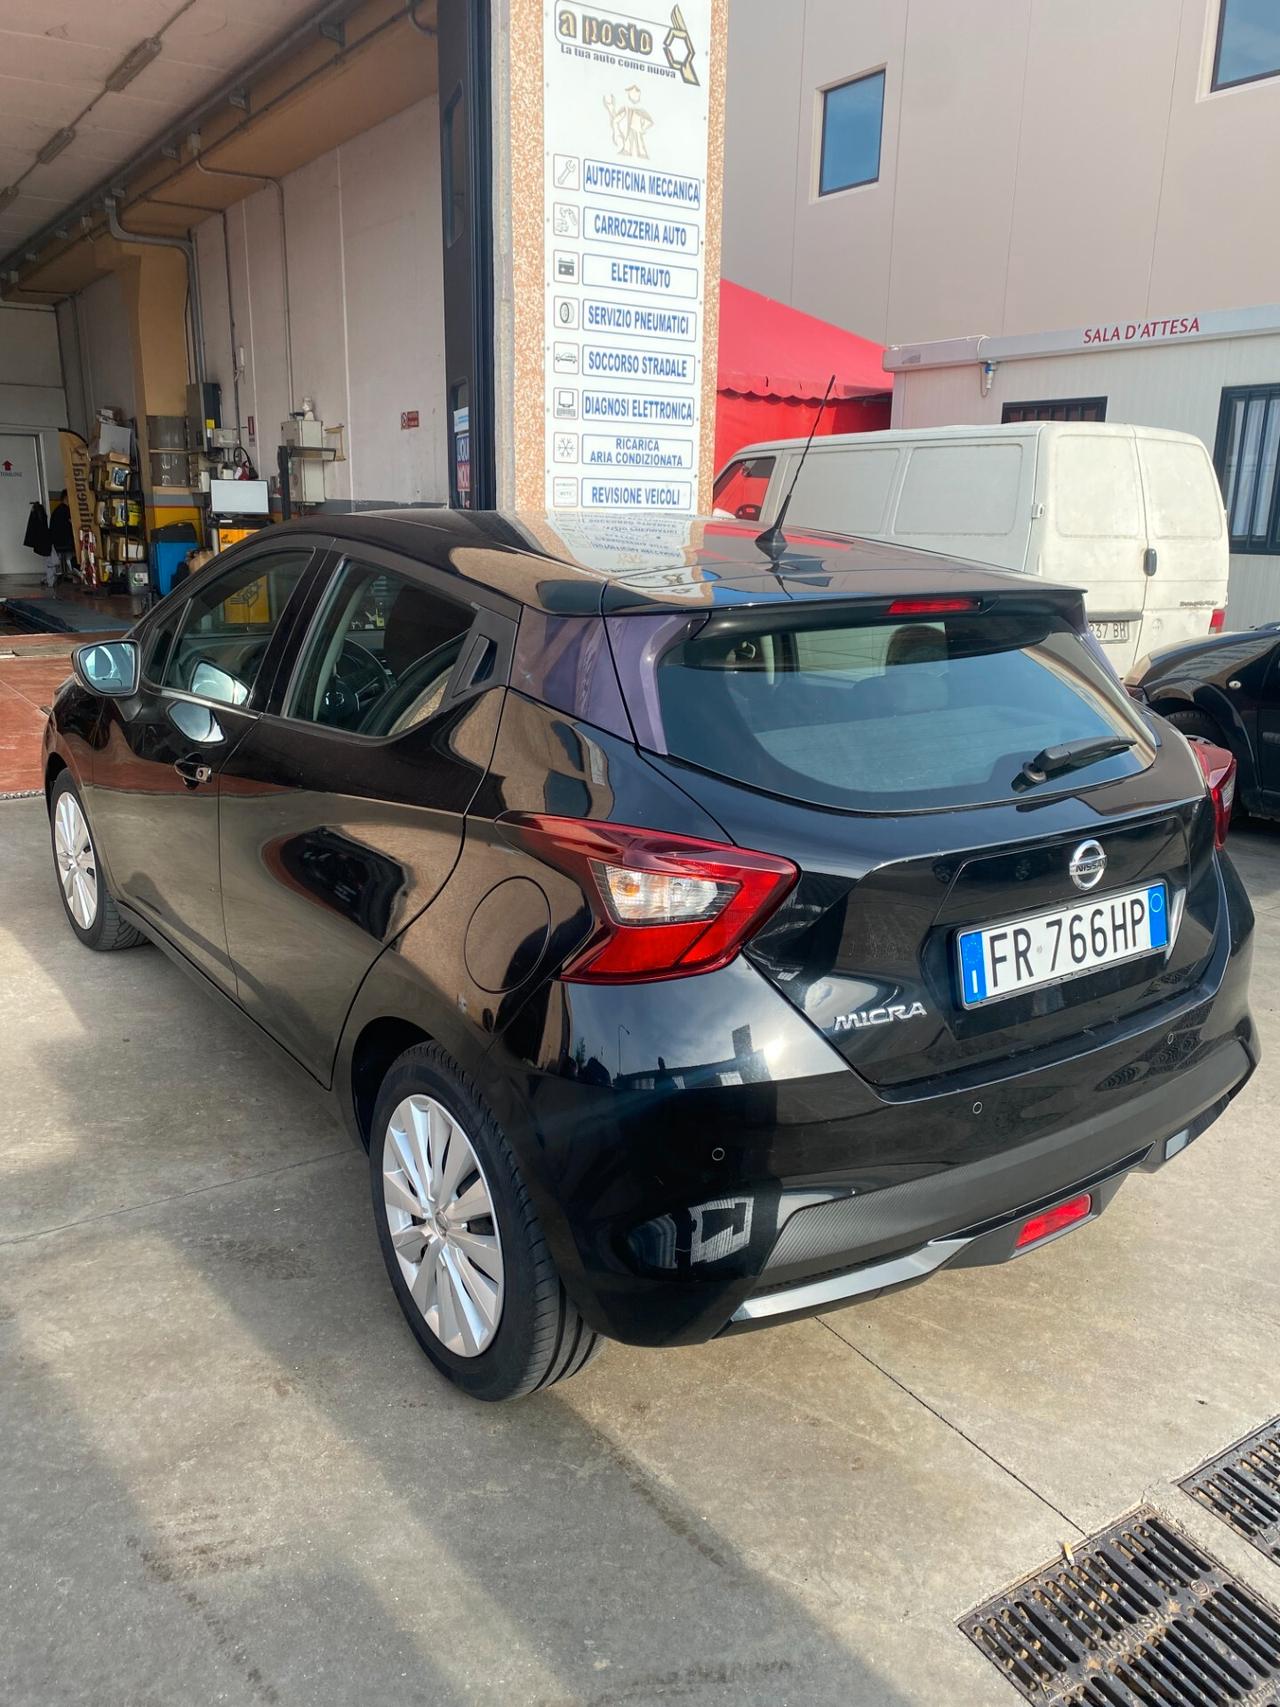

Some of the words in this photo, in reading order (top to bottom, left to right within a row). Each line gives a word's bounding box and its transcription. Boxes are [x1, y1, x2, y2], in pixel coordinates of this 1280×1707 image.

[559, 10, 577, 38] a
[582, 14, 653, 55] posto
[561, 43, 572, 55] La
[574, 46, 591, 59] tua
[593, 50, 616, 65] auto
[618, 58, 645, 72] come
[647, 65, 676, 79] nuova
[586, 165, 646, 193] AUTOFFICINA
[649, 175, 699, 202] MECCANICA
[594, 214, 660, 242] CARROZZERIA
[662, 225, 687, 246] AUTO
[611, 262, 671, 288] ELETTRAUTO
[588, 305, 632, 328] SERVIZIO
[634, 311, 689, 334] PNEUMATICI
[1083, 326, 1121, 344] SALA
[1125, 317, 1200, 340] D'ATTESA
[588, 351, 639, 373] SOCCORSO
[642, 356, 688, 377] STRADALE
[585, 396, 630, 417] DIAGNOSI
[632, 399, 692, 421] ELETTRONICA
[616, 438, 660, 452] RICARICA
[590, 450, 613, 463] ARIA
[615, 452, 683, 467] CONDIZIONATA
[592, 486, 642, 504] REVISIONE
[645, 488, 680, 505] VEICOLI
[1113, 622, 1126, 638] BH
[1076, 857, 1106, 872] NISSAN
[989, 928, 1034, 988] FR
[1046, 898, 1145, 972] 766HP
[833, 1002, 928, 1031] MICRA
